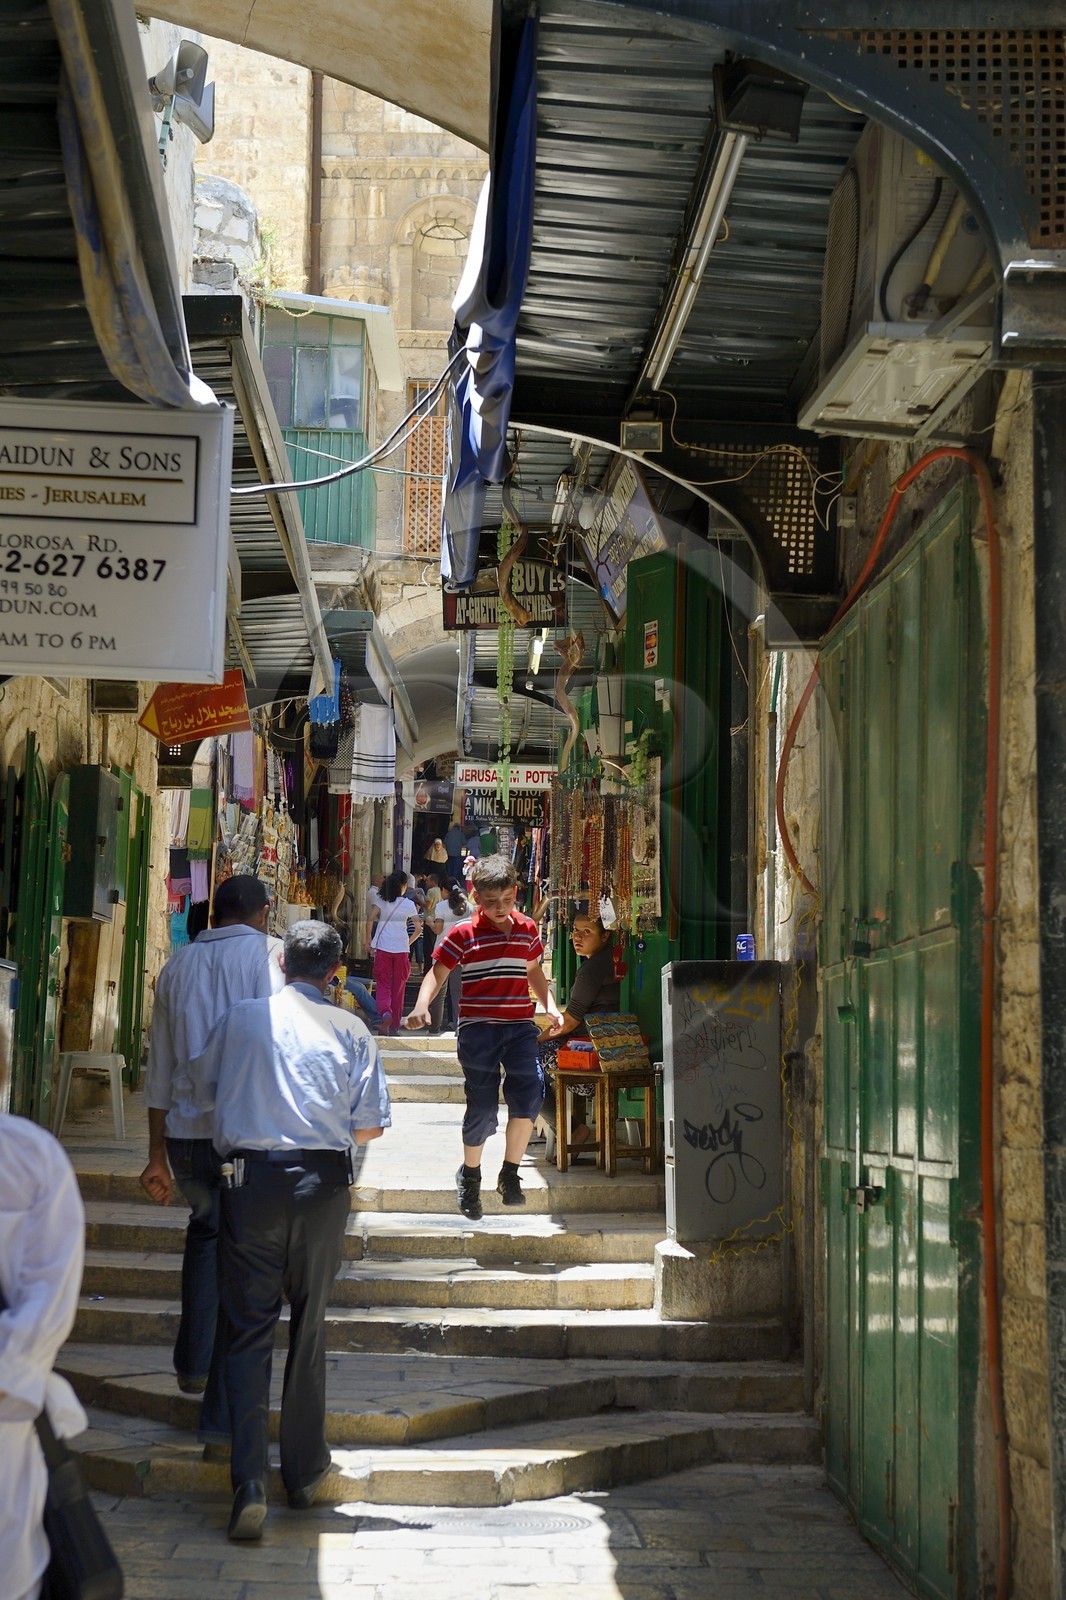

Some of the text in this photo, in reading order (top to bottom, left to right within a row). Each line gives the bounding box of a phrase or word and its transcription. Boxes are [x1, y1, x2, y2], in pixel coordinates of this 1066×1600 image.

[0, 445, 182, 472] AIDUN & SONS
[0, 487, 25, 501] IES
[43, 486, 147, 506] JERUSALEM
[0, 550, 167, 582] 2-627 6387
[515, 562, 546, 593] BUY
[25, 582, 43, 596] 50
[48, 583, 67, 597] 80
[36, 633, 64, 648] TO
[71, 632, 83, 649] 6
[89, 635, 117, 650] PM
[183, 712, 195, 728] بن
[197, 705, 217, 725] بلال
[218, 703, 249, 719] مسجد
[161, 715, 182, 736] رباح
[459, 769, 520, 783] JERUSAM
[474, 797, 499, 816] MIKE
[536, 817, 544, 826] 12
